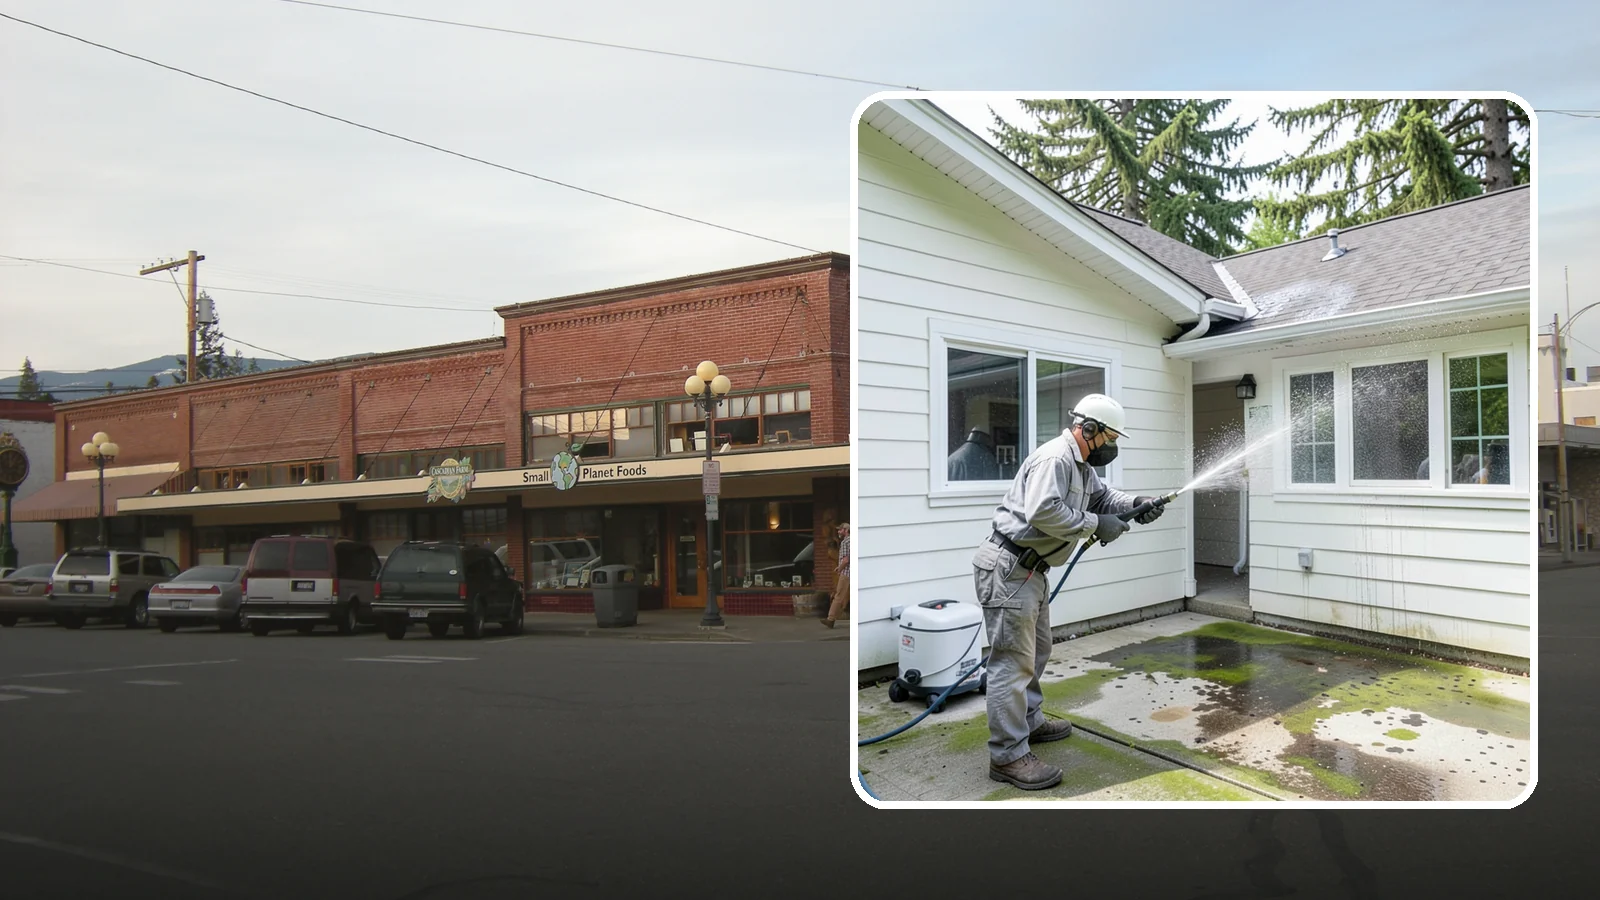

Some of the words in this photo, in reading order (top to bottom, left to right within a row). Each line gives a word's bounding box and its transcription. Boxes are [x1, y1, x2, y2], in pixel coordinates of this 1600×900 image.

[523, 471, 549, 483] Small
[582, 467, 614, 479] Planet
[617, 465, 647, 477] Foods
